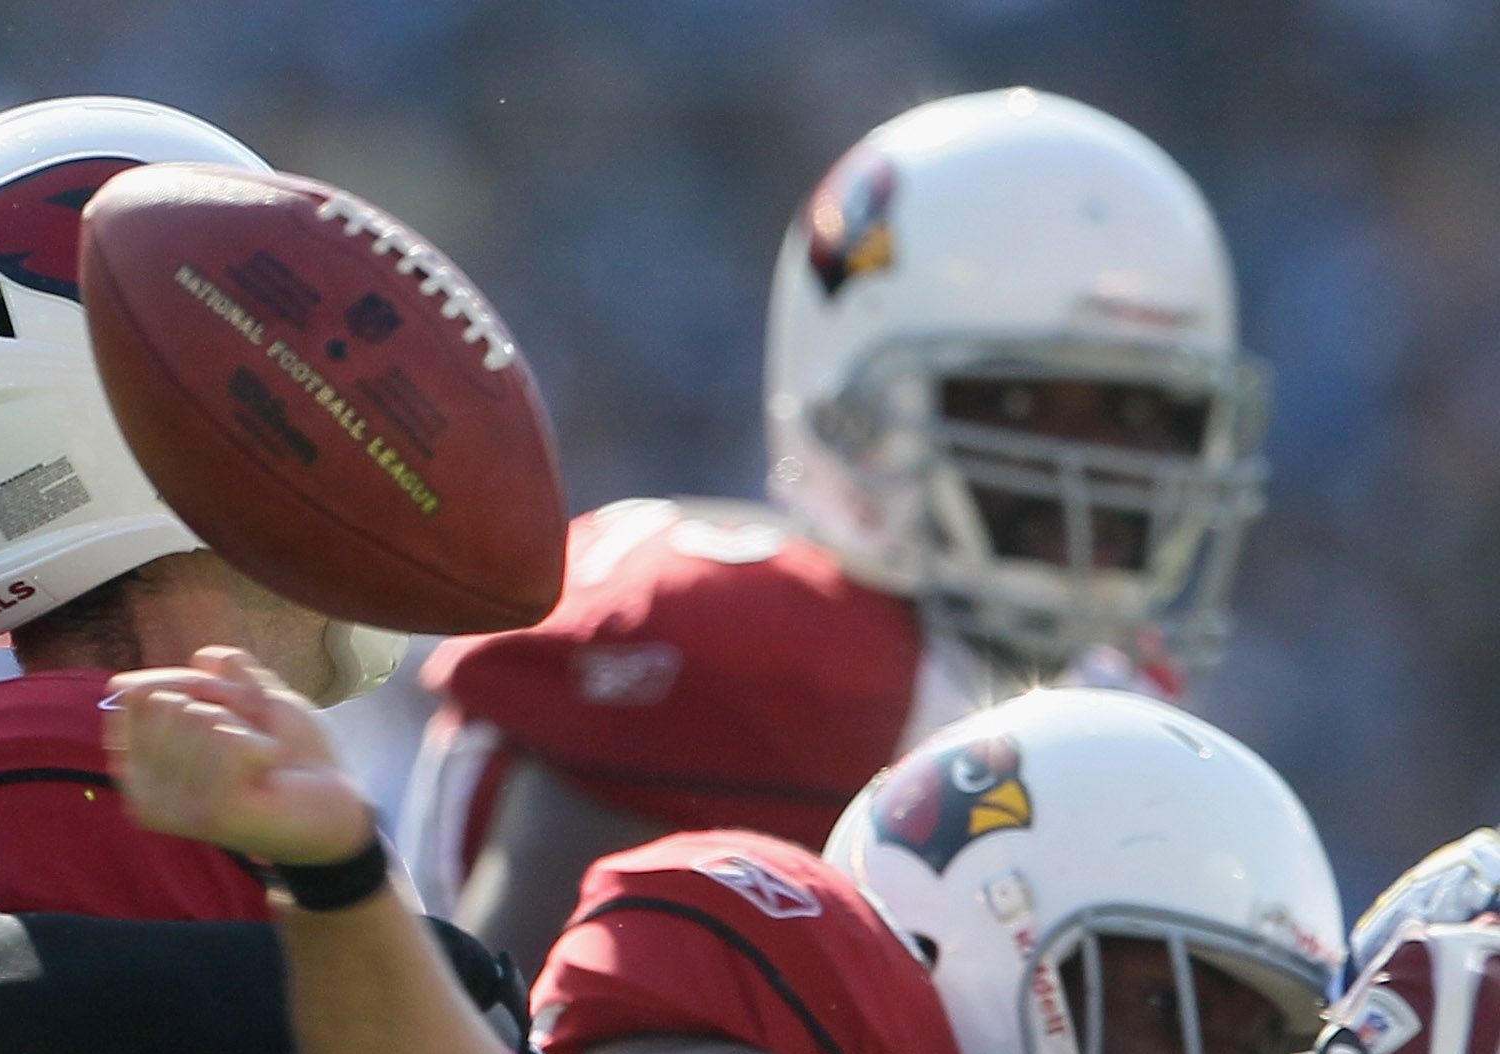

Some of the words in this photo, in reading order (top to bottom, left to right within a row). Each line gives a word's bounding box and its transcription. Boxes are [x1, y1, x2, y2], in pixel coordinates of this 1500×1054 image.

[175, 264, 264, 346] NATIONAL
[266, 340, 367, 440] FOOTBALL
[366, 436, 441, 518] LEAGUE
